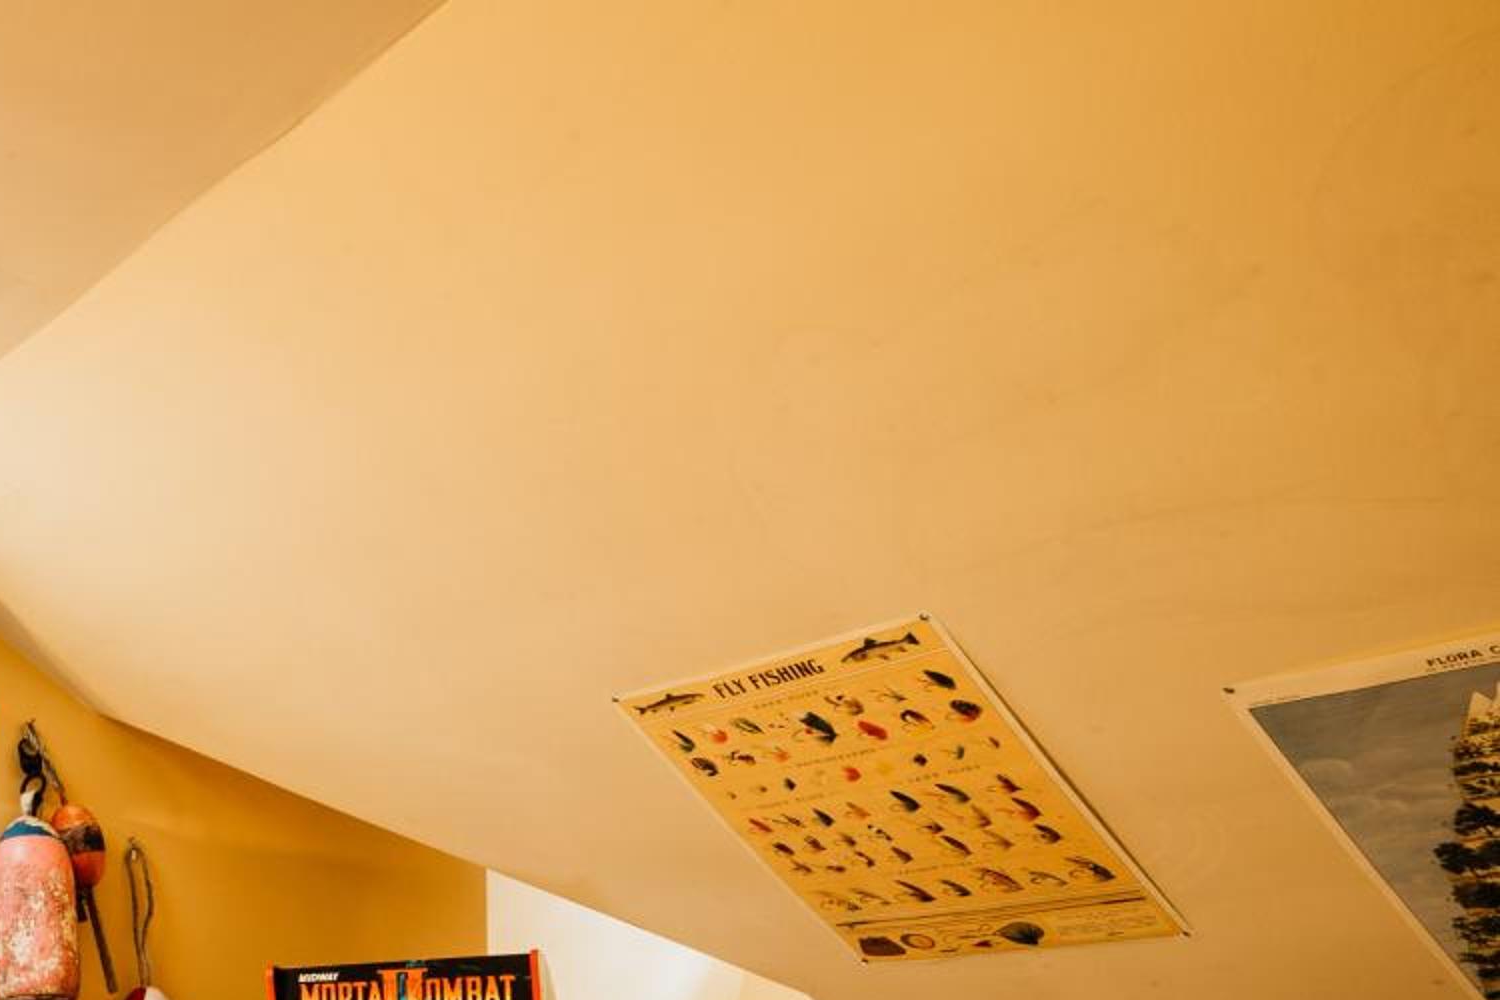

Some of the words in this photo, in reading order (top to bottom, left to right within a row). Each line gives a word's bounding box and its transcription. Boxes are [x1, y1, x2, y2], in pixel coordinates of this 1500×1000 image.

[1426, 649, 1484, 667] FLORA
[713, 679, 747, 699] FLY
[748, 659, 825, 690] FISHING
